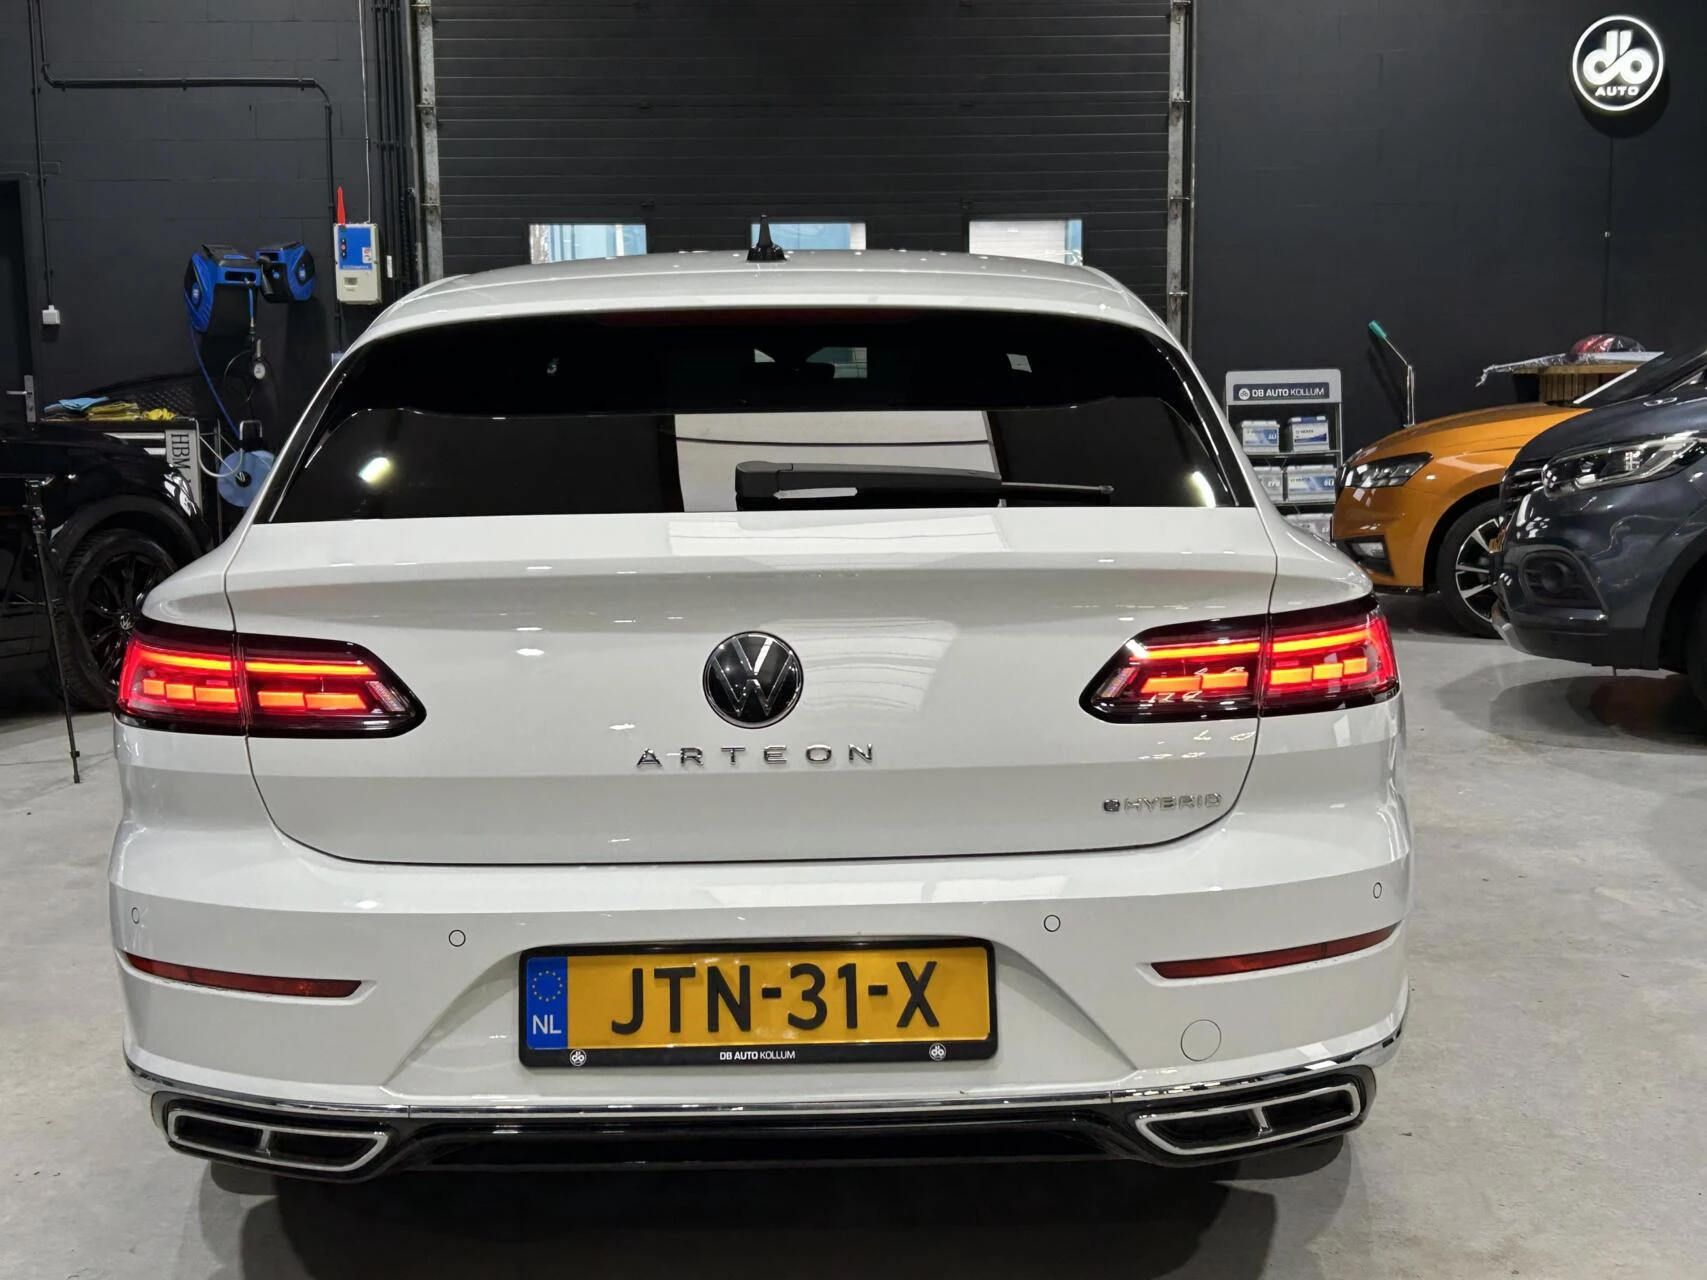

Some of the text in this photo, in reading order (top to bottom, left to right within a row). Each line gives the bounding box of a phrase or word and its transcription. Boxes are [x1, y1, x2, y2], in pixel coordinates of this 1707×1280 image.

[1594, 85, 1640, 97] AUTO
[1252, 389, 1264, 397] DB
[1266, 388, 1289, 397] AUTO
[1290, 387, 1325, 396] KOLLUM
[171, 433, 192, 469] HBM
[637, 743, 874, 766] ARTEON
[611, 960, 940, 1034] JTN-31-X
[532, 1015, 562, 1036] NL
[720, 1050, 796, 1060] DB AUTO KOLLUM
